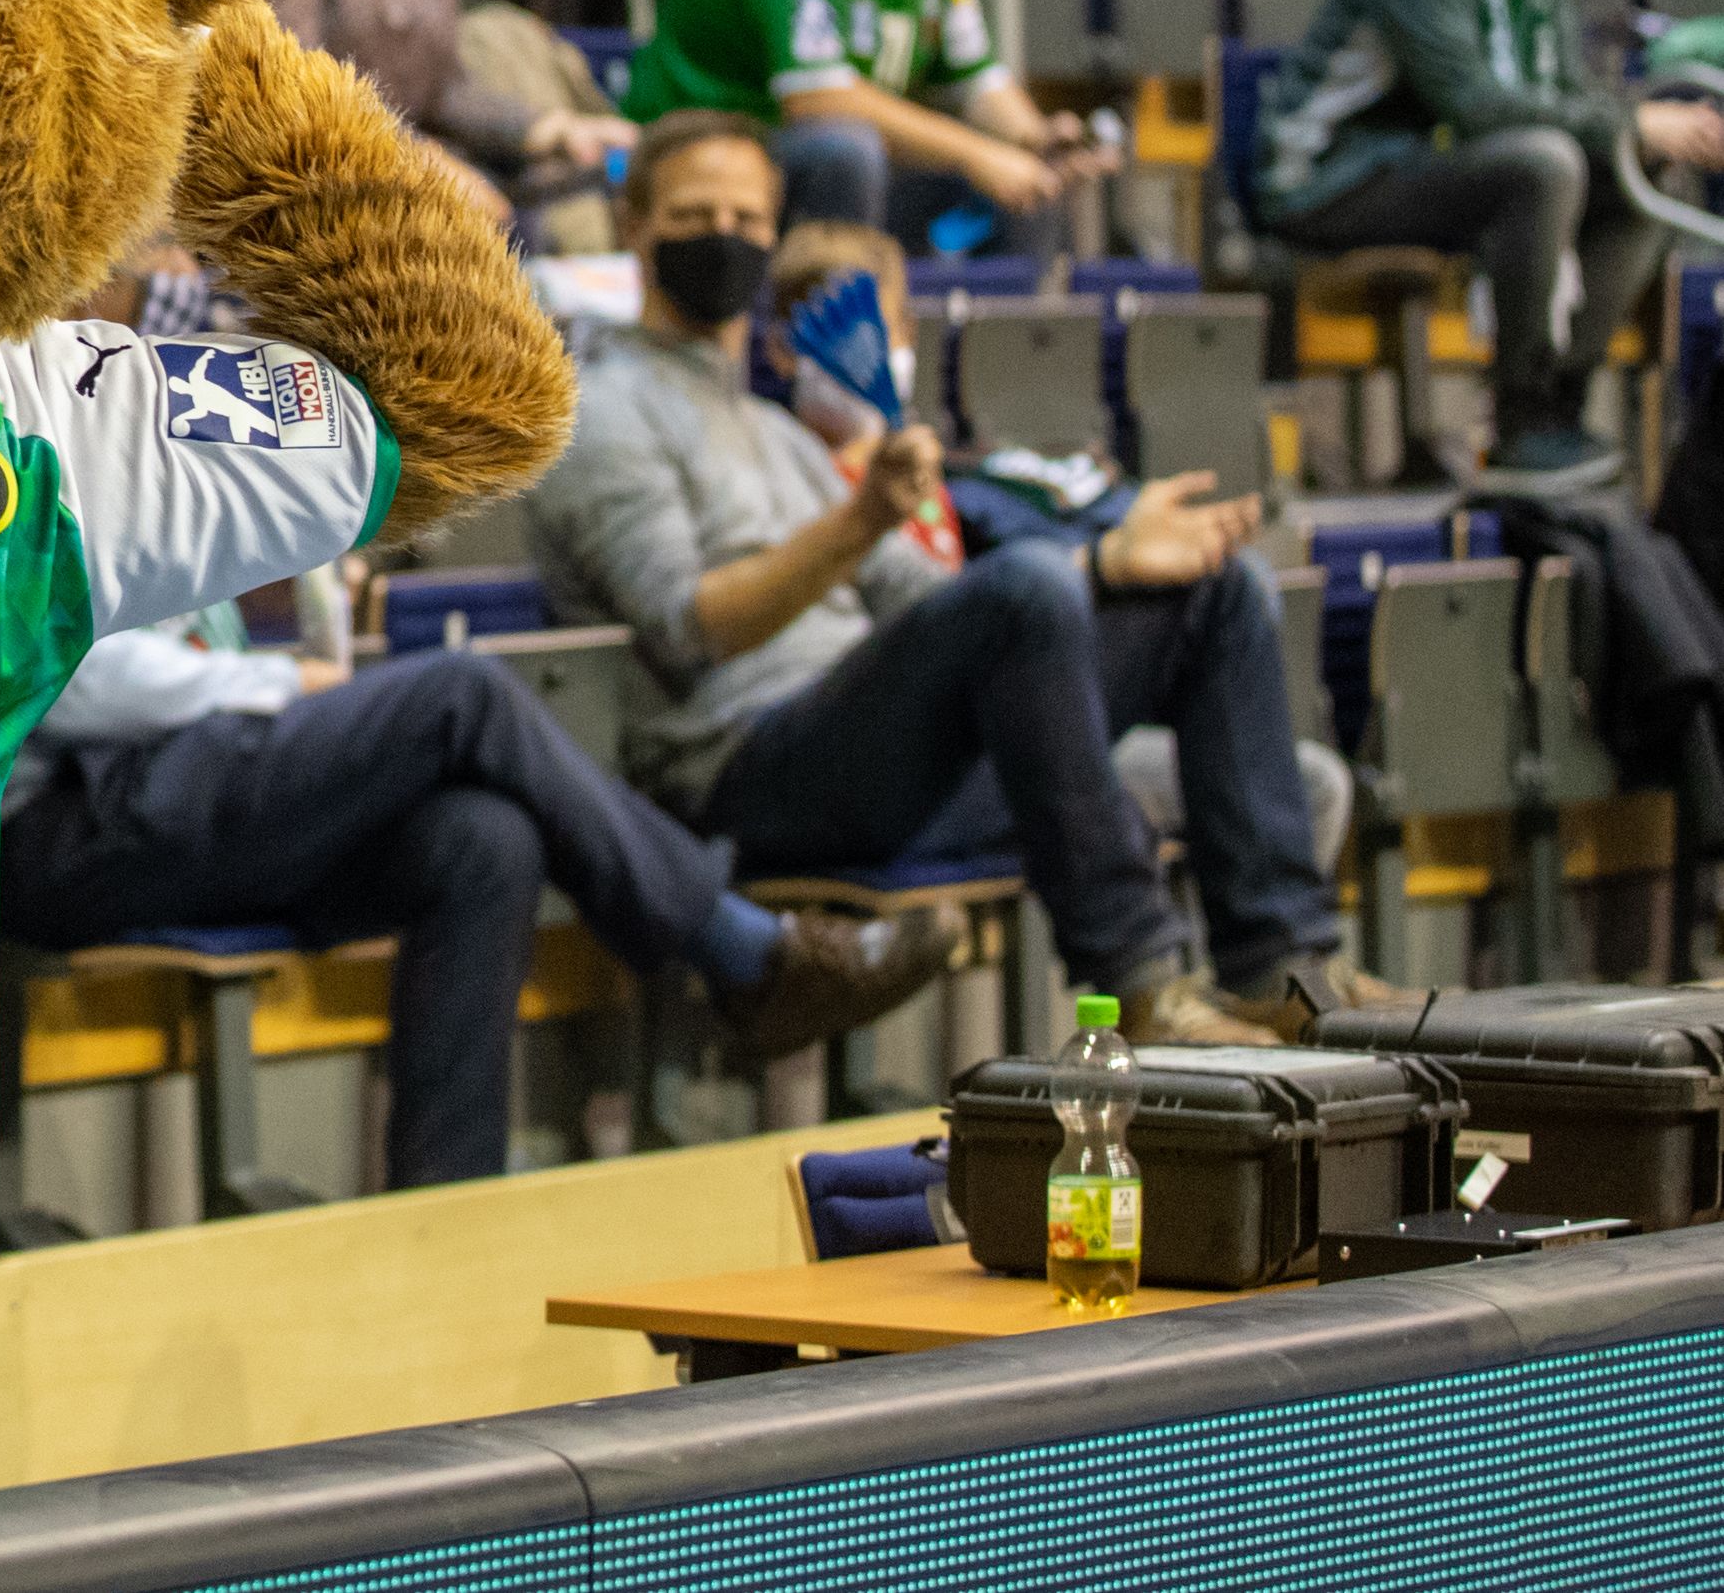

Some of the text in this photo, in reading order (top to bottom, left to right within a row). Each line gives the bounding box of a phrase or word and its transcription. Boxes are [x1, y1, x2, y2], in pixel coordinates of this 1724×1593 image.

[236, 348, 272, 402] HBL
[274, 365, 301, 424] LIQUI
[293, 362, 323, 420] MOLY
